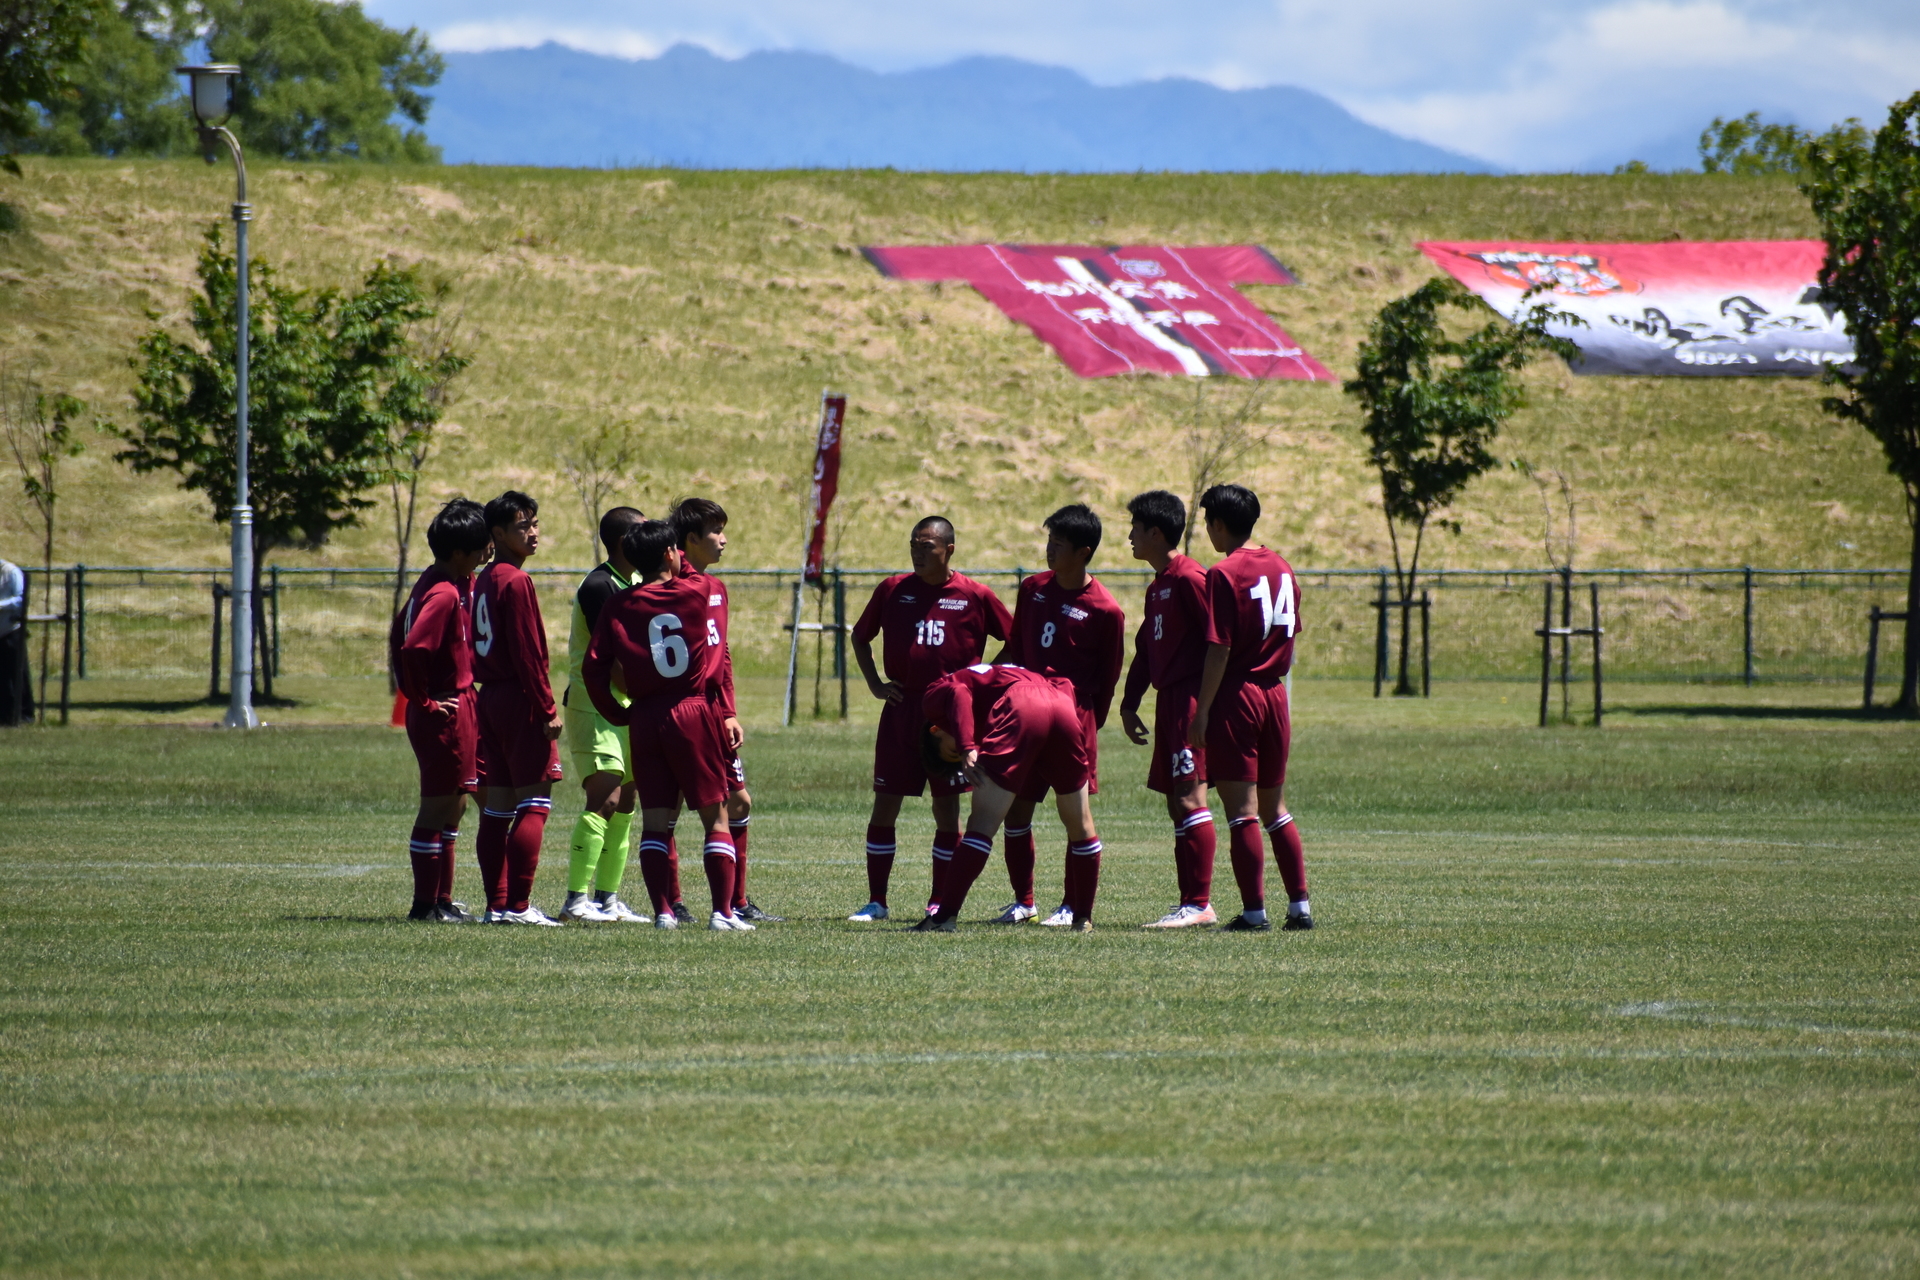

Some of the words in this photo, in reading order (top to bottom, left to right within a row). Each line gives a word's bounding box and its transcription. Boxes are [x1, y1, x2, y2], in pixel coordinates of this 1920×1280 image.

[475, 593, 493, 657] 9
[1249, 572, 1296, 641] 14
[648, 613, 690, 679] 6
[915, 619, 946, 646] 115
[1040, 621, 1057, 648] 8
[1172, 749, 1195, 778] 23
